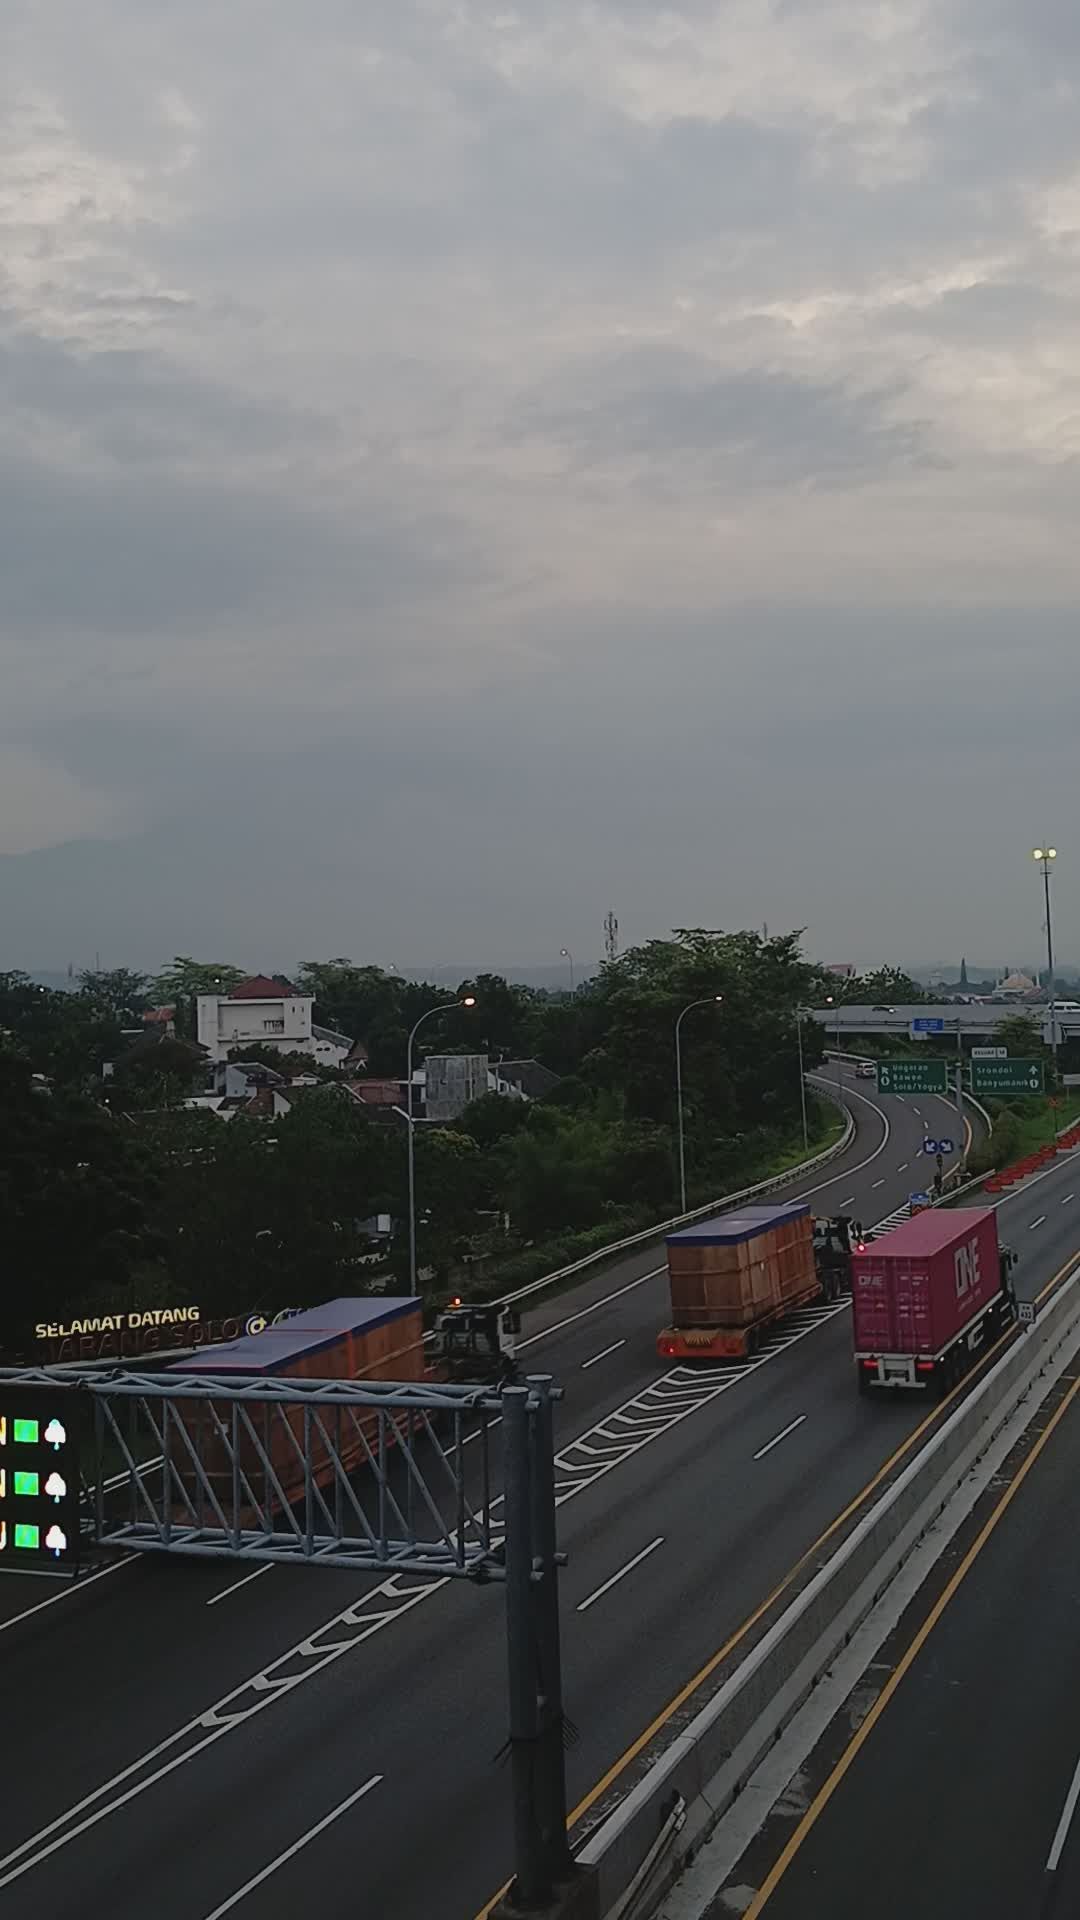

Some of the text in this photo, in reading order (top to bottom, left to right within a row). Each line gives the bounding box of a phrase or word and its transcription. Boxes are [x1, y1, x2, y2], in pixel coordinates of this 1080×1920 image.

[892, 1064, 928, 1074] Ungaran
[976, 1066, 1013, 1074] Srondol
[893, 1073, 922, 1081] Bawen
[893, 1083, 943, 1092] Solo/Yogya
[976, 1079, 1029, 1088] Banyumanik
[954, 1236, 981, 1298] ONE
[858, 1275, 884, 1286] ONE
[35, 1306, 200, 1339] SELAMAT DATANG
[47, 1317, 240, 1362] ARANG SOLO
